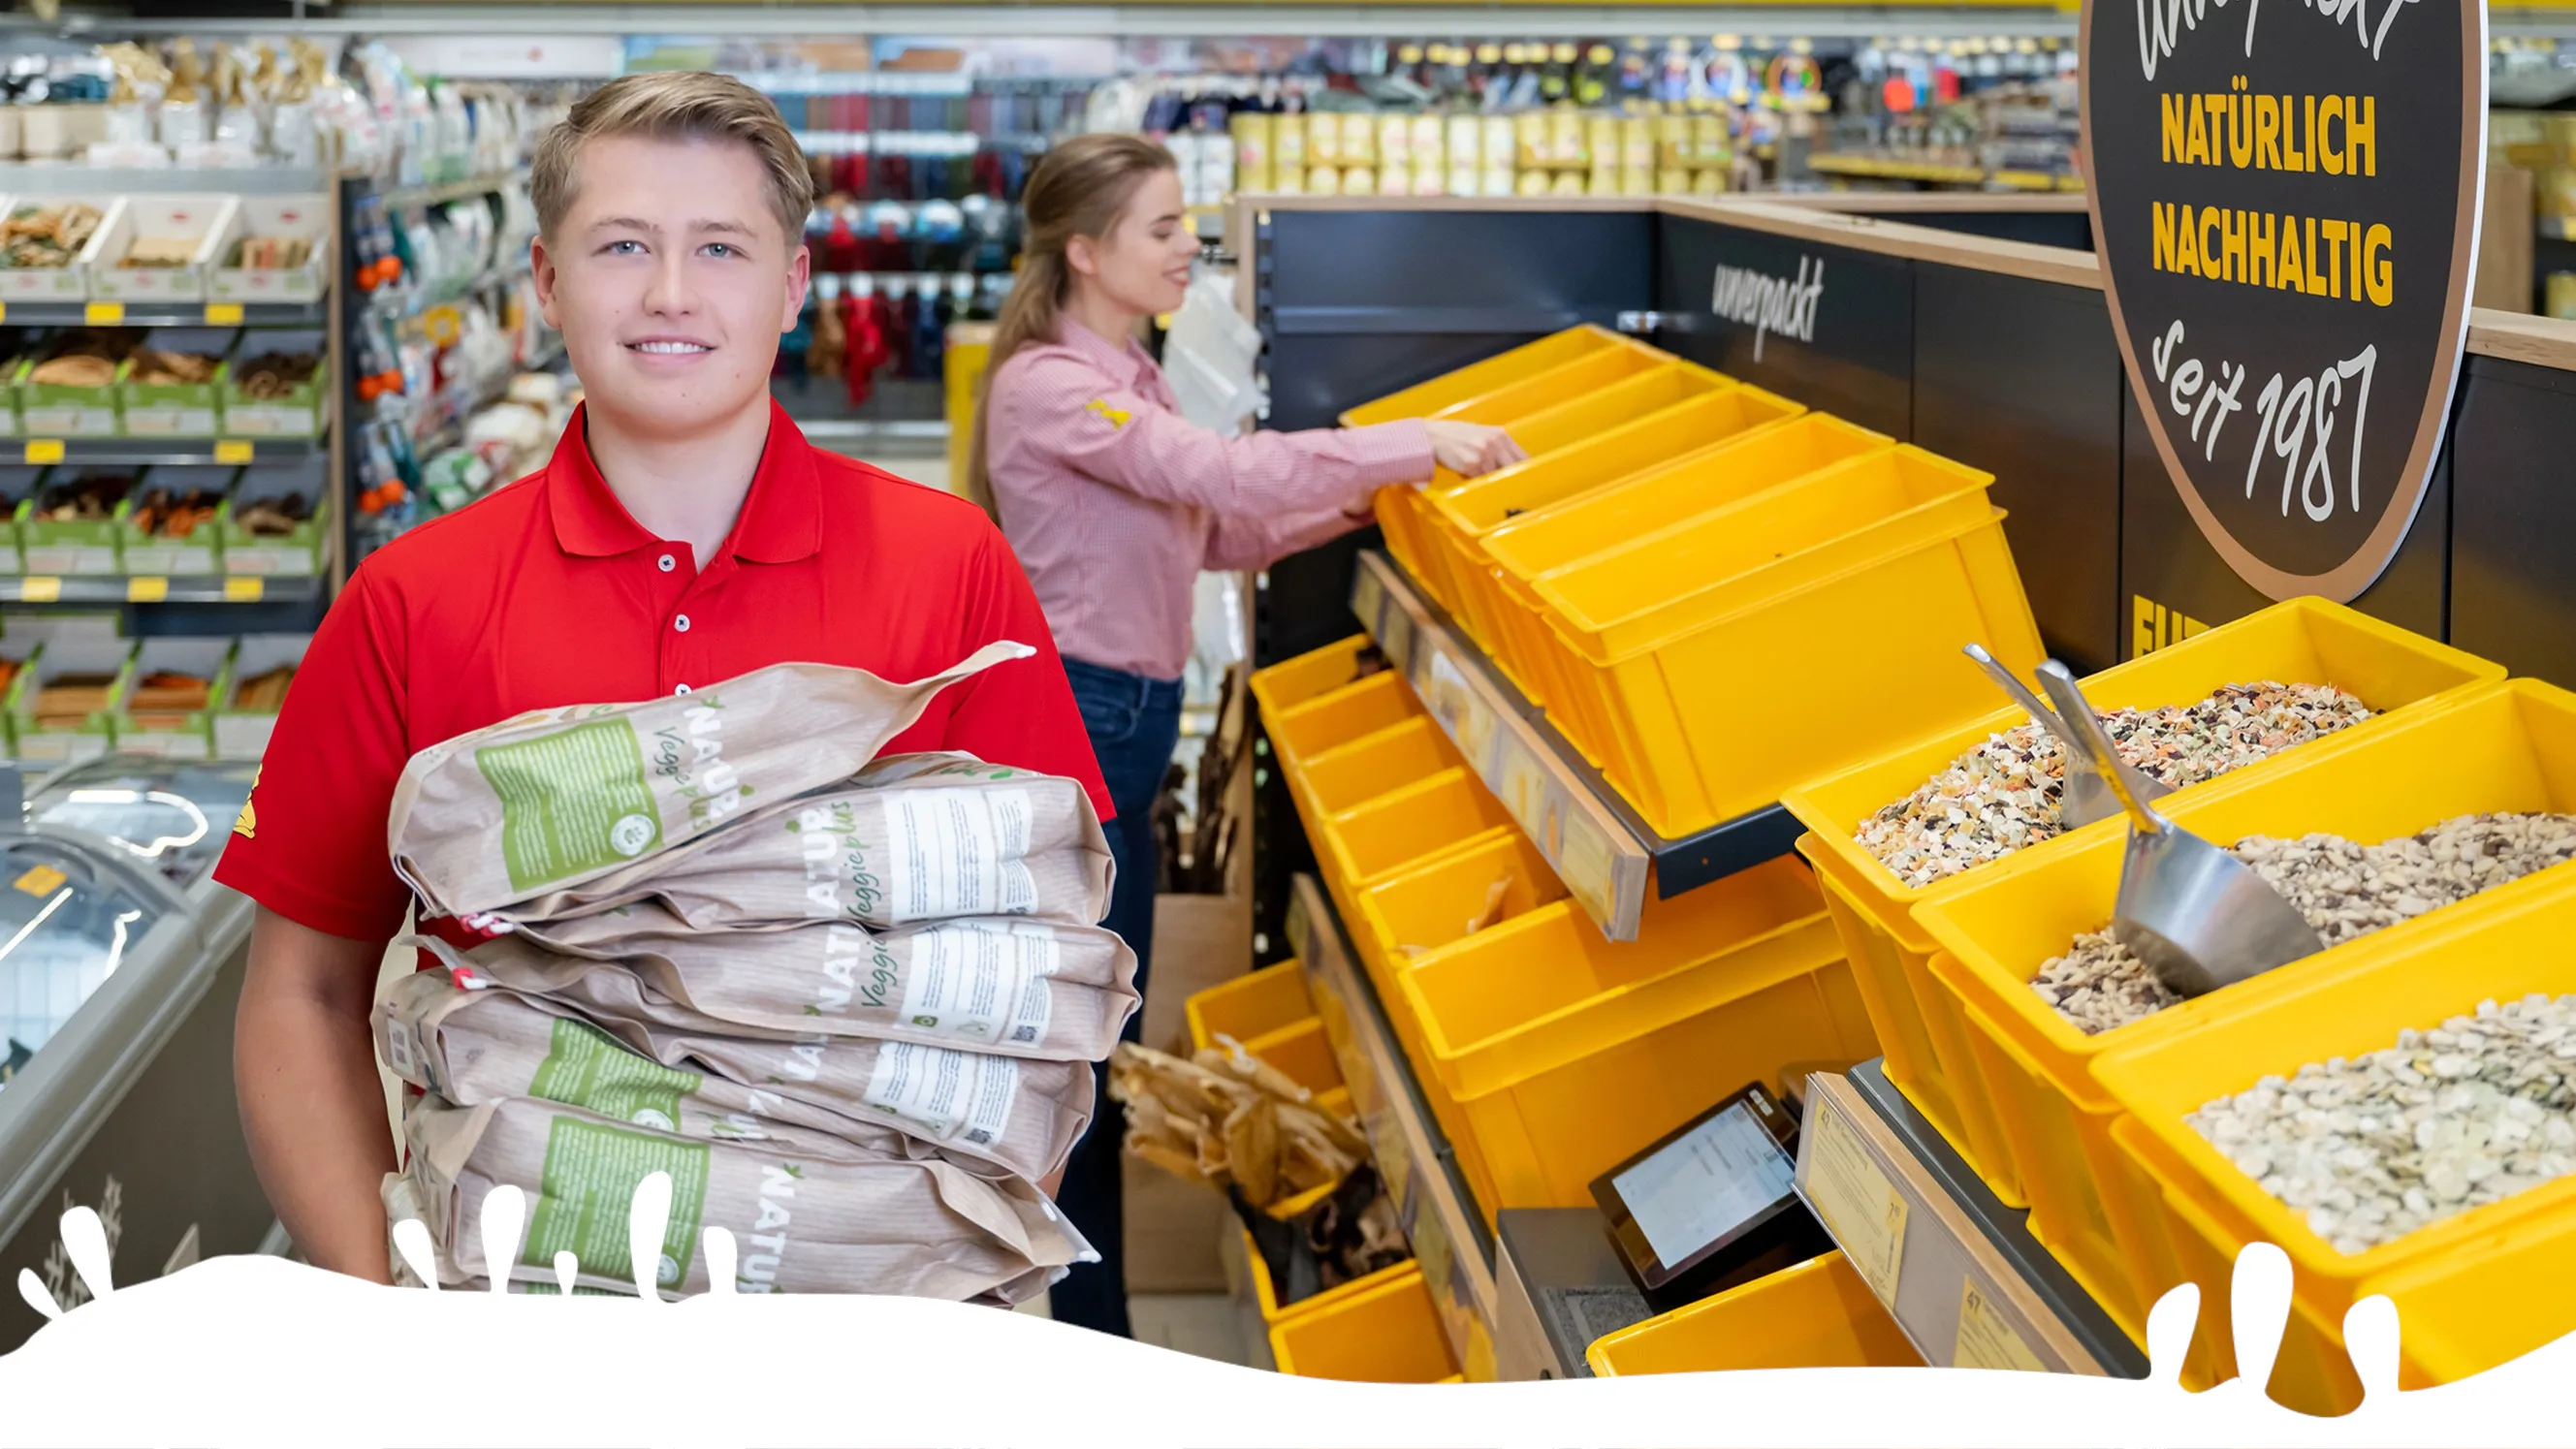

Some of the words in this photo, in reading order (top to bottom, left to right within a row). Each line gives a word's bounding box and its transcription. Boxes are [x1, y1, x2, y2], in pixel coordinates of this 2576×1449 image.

[2161, 75, 2375, 176] NATÜRLICH
[2152, 202, 2393, 306] NACHHALTIG
[2246, 344, 2376, 521] 1987
[684, 706, 740, 820] NAUR
